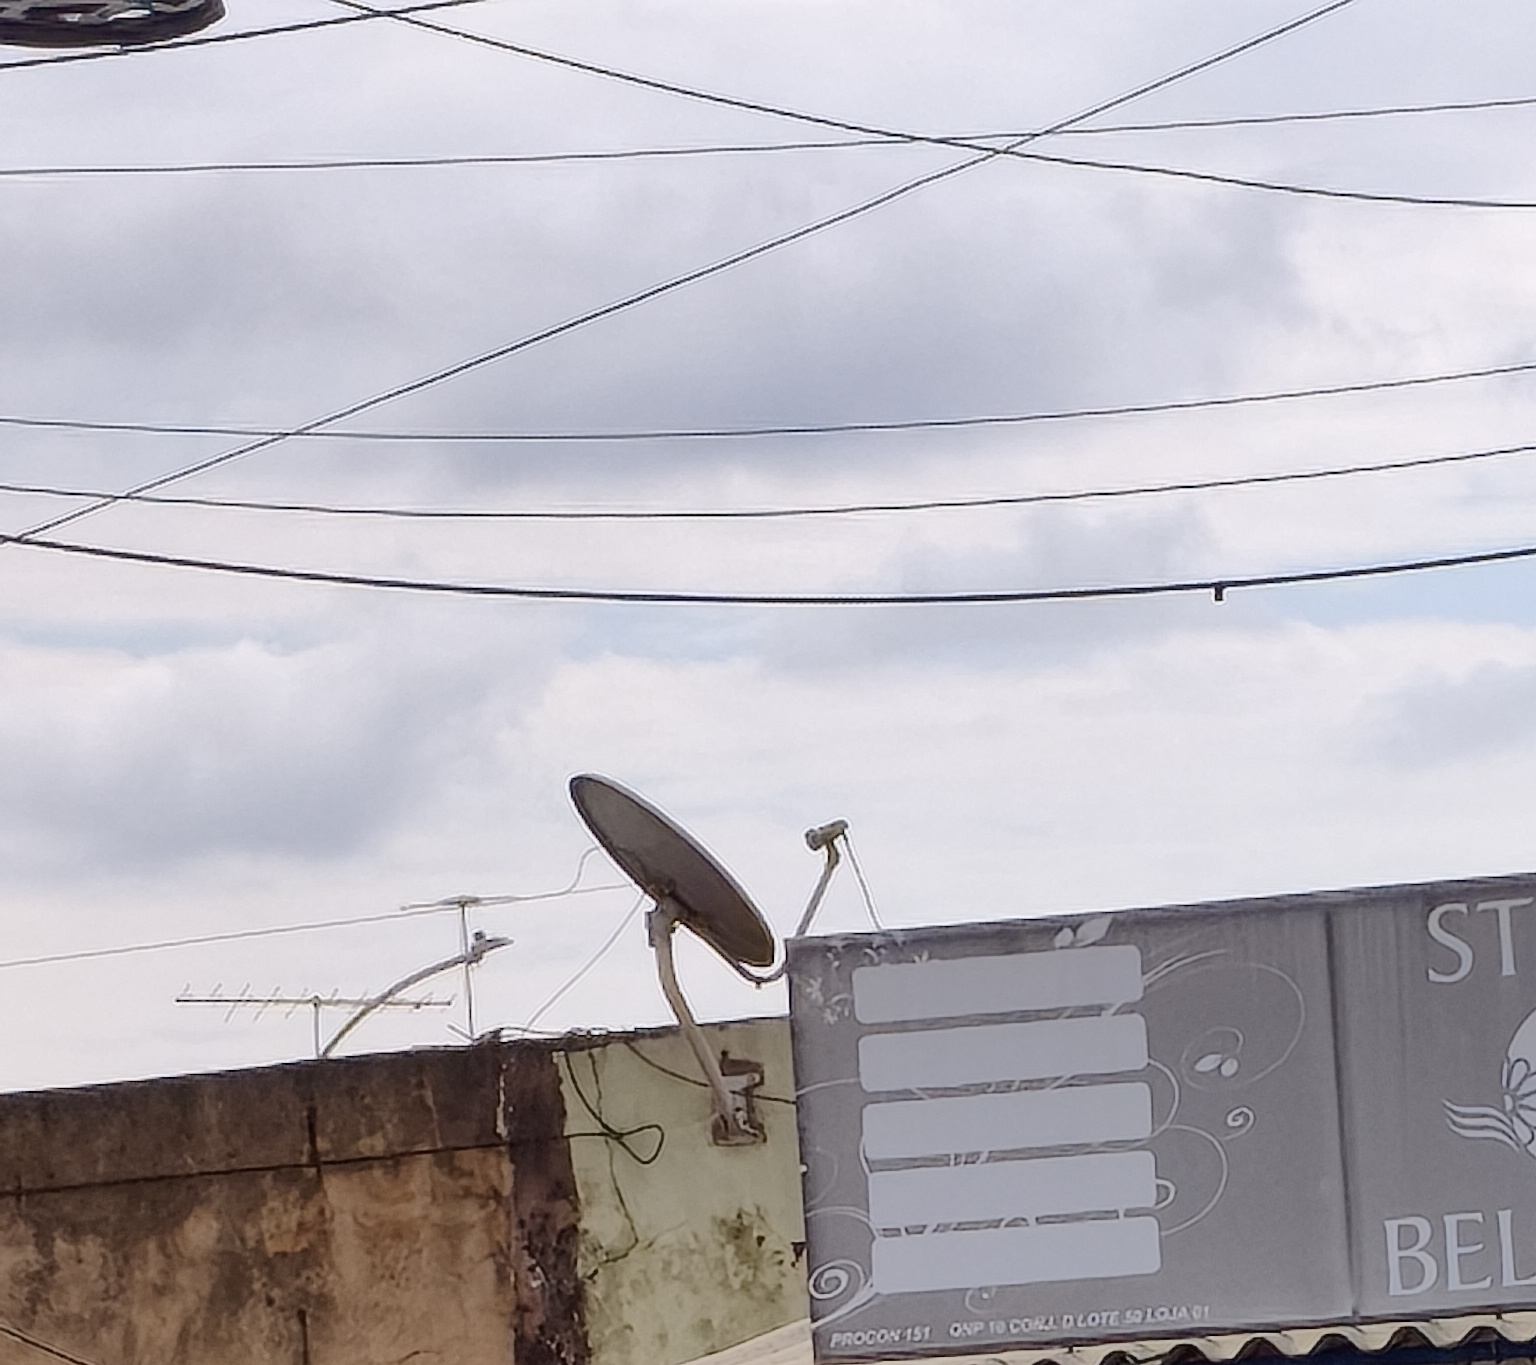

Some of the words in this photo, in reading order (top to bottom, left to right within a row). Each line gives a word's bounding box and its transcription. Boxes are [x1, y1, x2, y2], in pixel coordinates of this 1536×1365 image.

[1077, 1310, 1120, 1328] LOTE
[1145, 1305, 1192, 1323] LOJA
[829, 1328, 901, 1348] PROCON
[904, 1325, 932, 1342] 151
